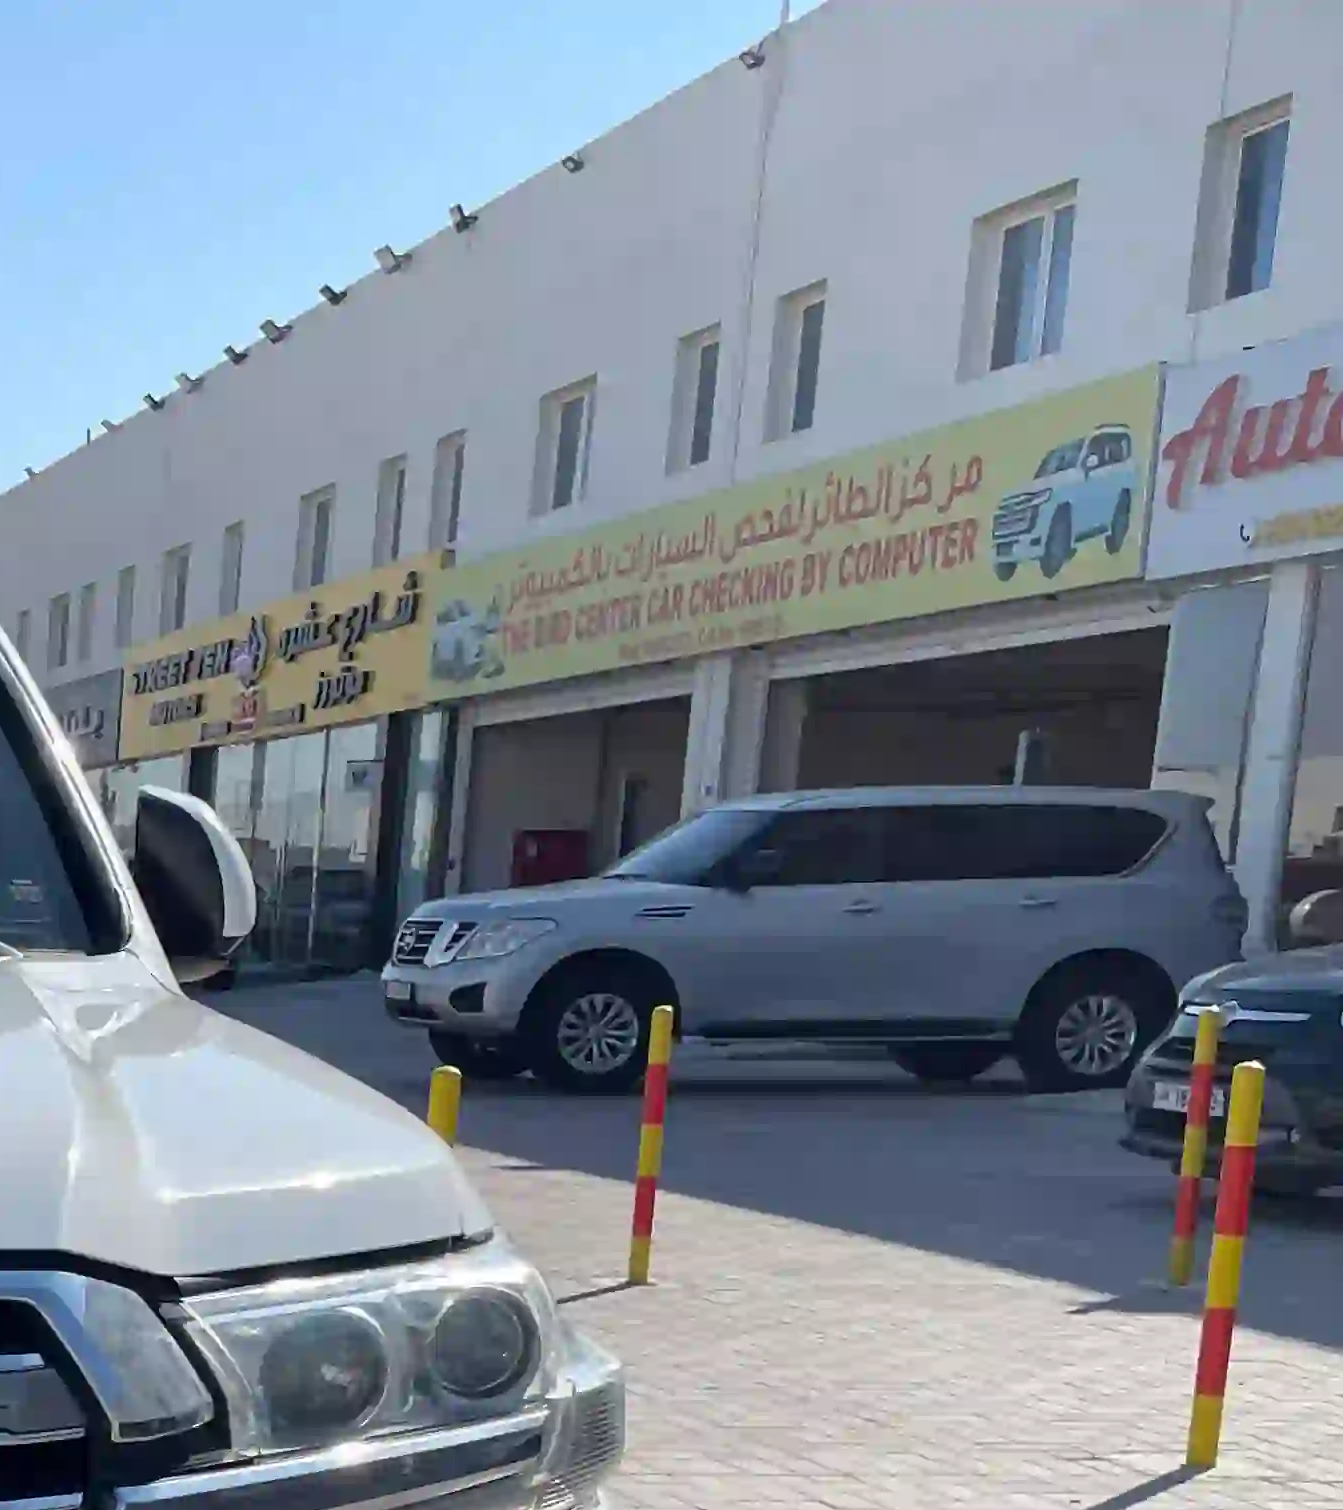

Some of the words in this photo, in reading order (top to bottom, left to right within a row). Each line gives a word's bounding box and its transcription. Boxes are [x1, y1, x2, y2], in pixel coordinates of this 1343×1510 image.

[801, 459, 894, 544] الطائر
[890, 454, 983, 523] مركز
[689, 557, 797, 616] CHECKING
[801, 550, 832, 597] BY
[838, 517, 980, 588] COMPUTER
